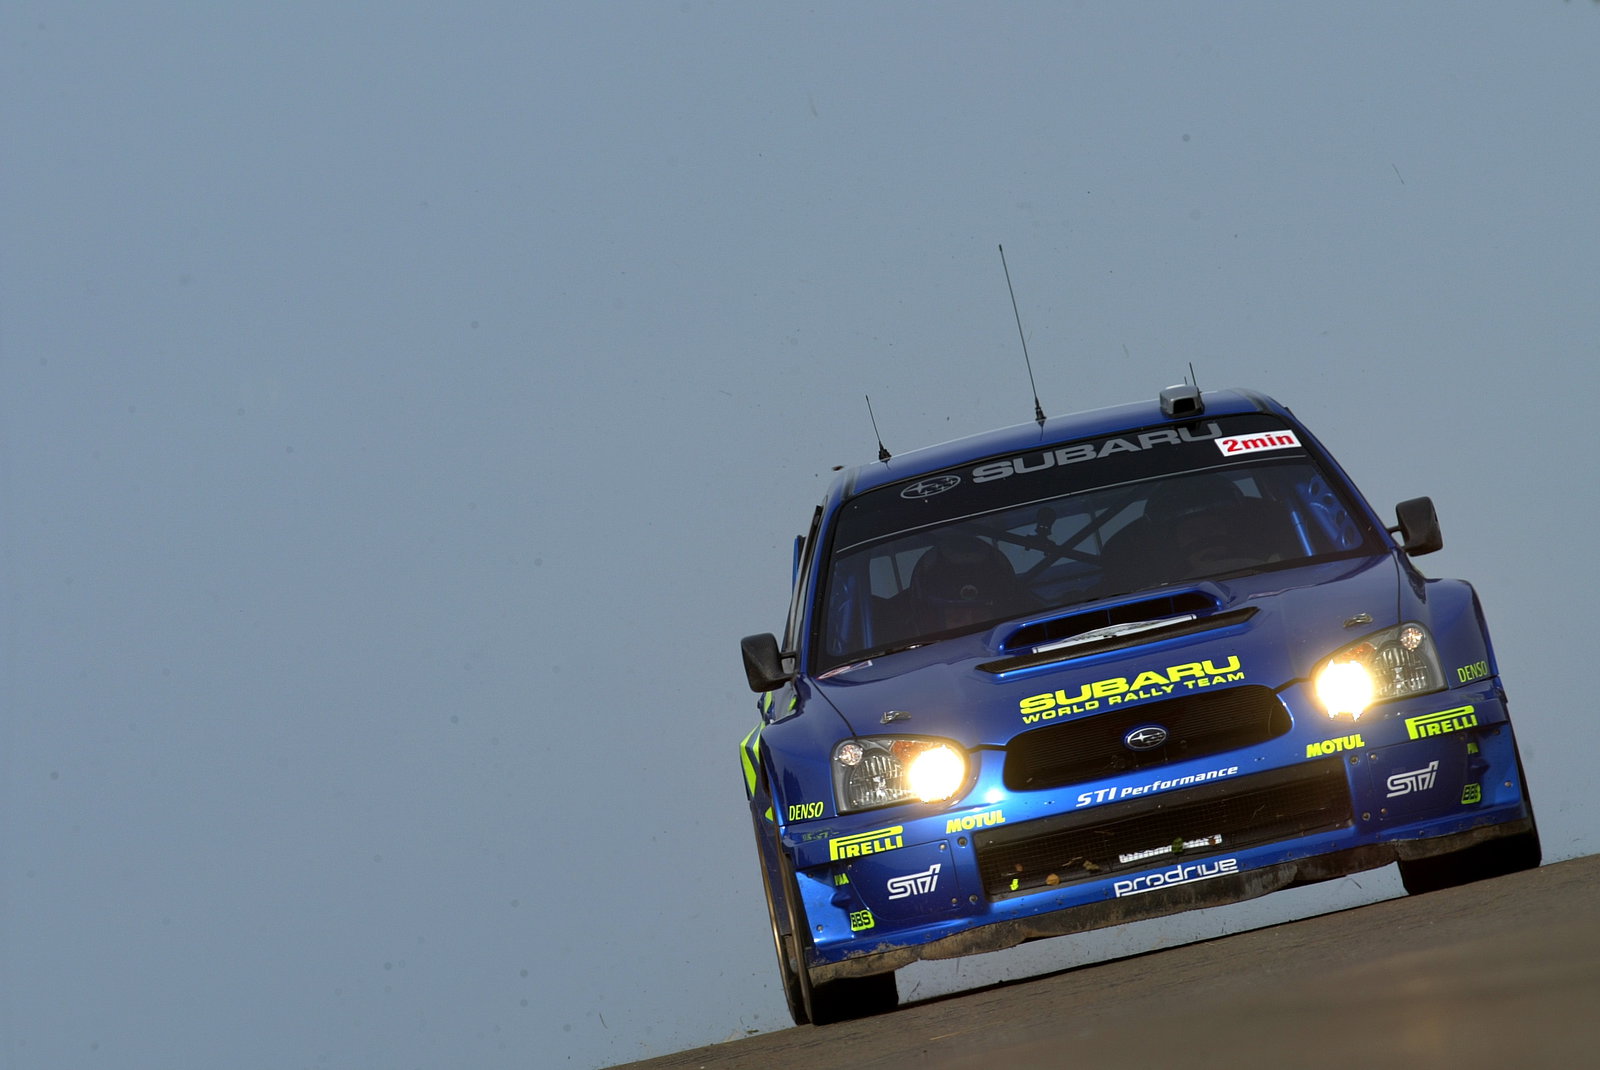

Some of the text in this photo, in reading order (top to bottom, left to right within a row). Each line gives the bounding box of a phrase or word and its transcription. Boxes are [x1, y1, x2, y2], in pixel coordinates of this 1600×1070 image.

[972, 423, 1223, 484] SUBARU
[1222, 430, 1295, 454] 2min
[1020, 655, 1241, 714] SUBARU
[1457, 661, 1489, 683] DENSO
[1022, 672, 1245, 724] WORLD RALLY TEAM
[1405, 705, 1478, 740] PIRELLI
[1306, 734, 1365, 758] MOTUL
[1076, 766, 1239, 807] STI Performance
[788, 801, 824, 821] DENSO
[946, 810, 1006, 834] MOTUL
[829, 825, 903, 861] PIRELLI
[1113, 858, 1239, 898] prodrive
[851, 912, 872, 928] BBS
